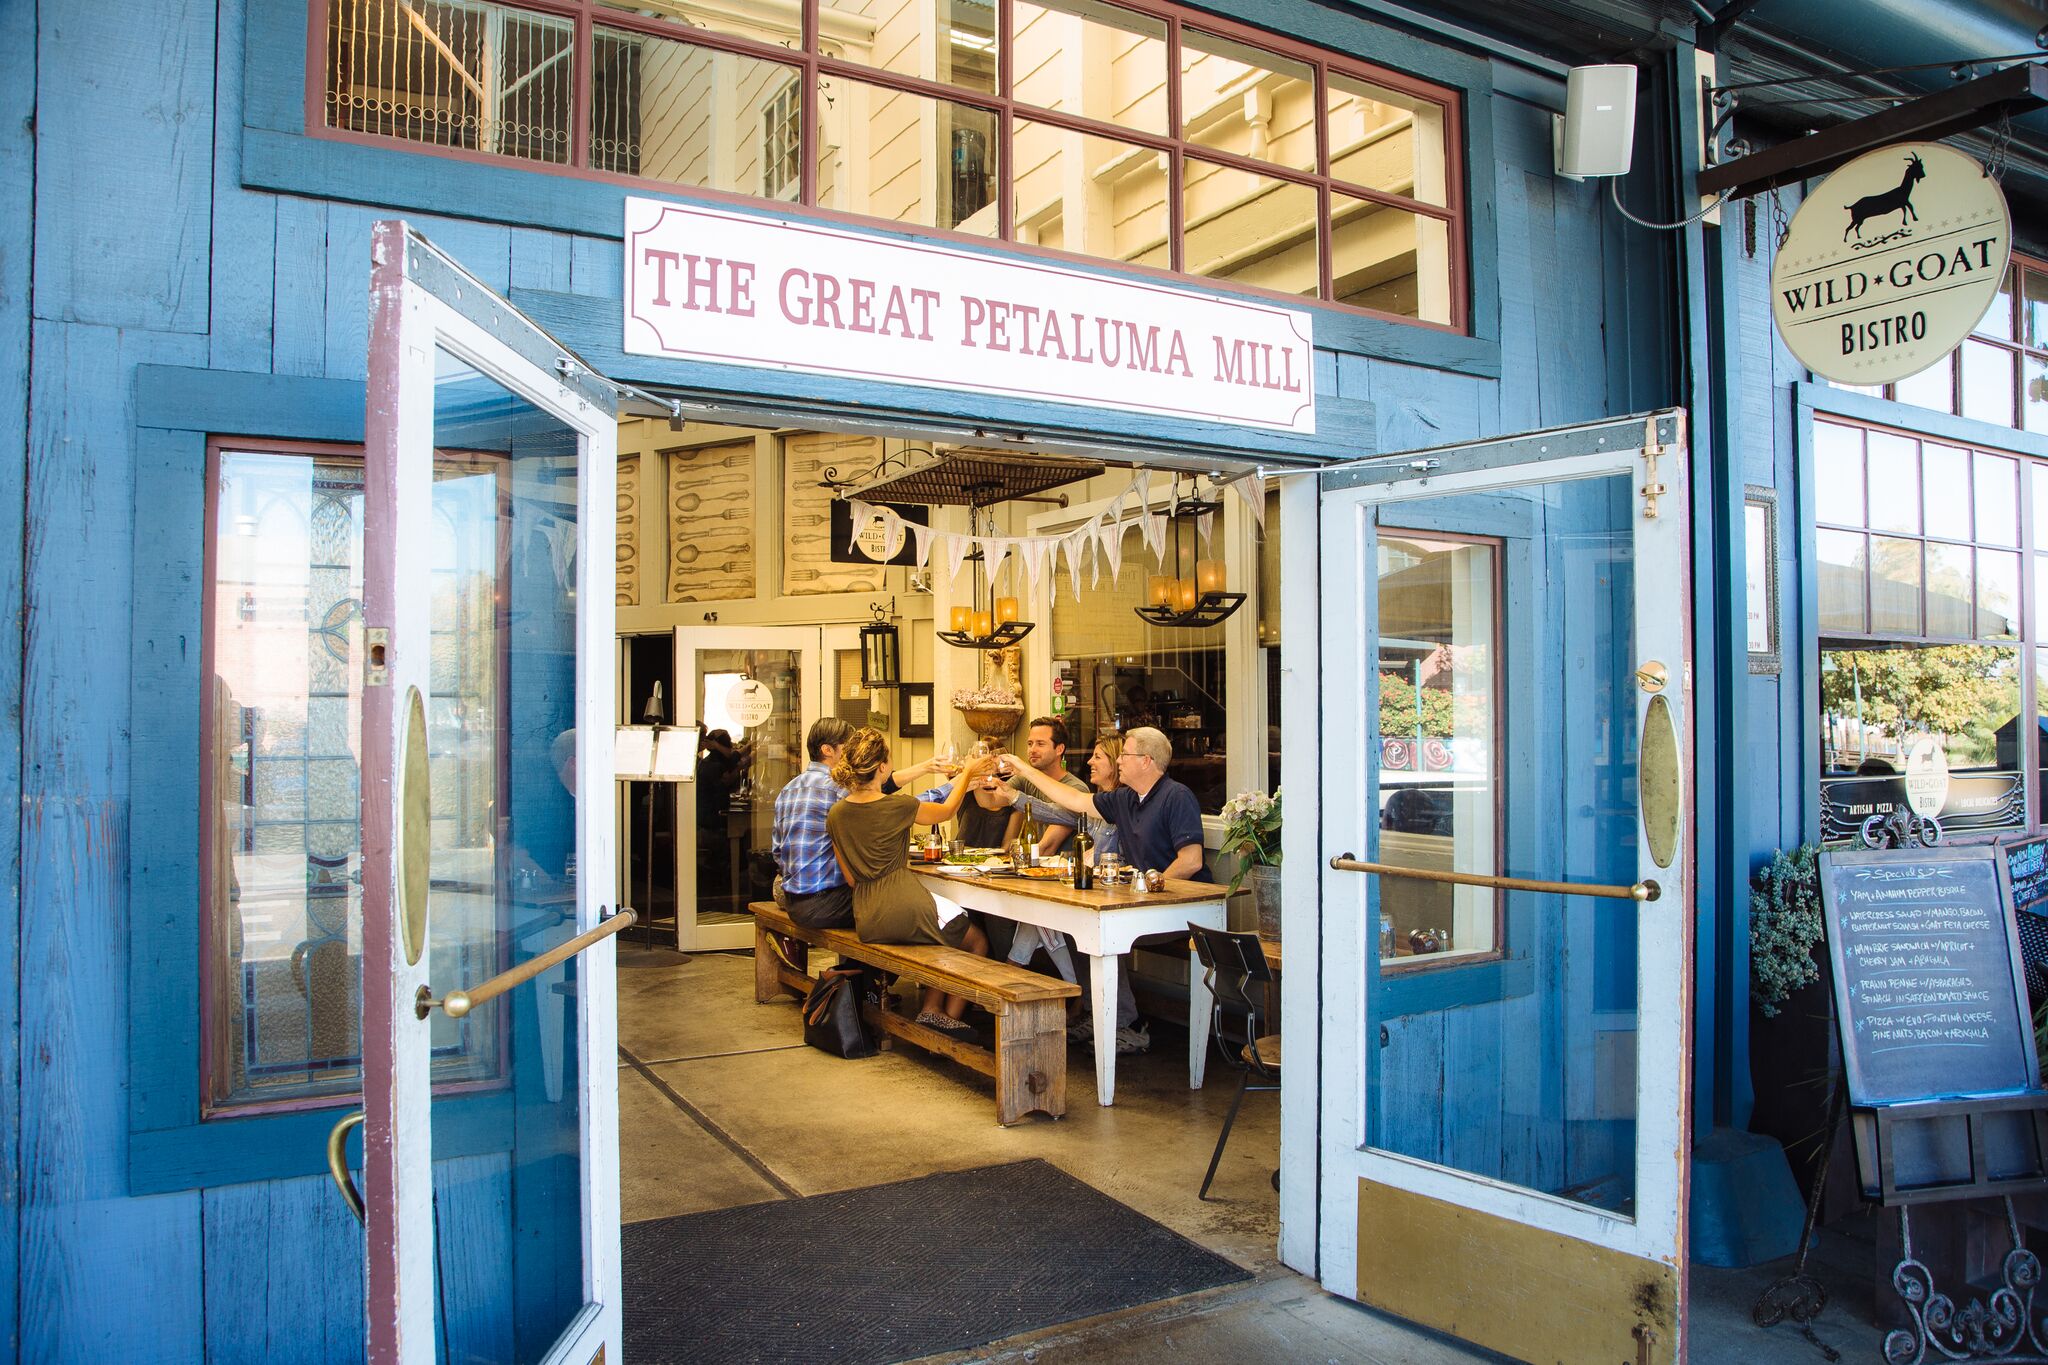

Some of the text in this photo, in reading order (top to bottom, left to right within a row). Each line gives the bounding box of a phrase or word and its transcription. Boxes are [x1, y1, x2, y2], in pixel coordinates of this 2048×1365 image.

[1783, 237, 1997, 314] WILD GOAT
[644, 248, 1302, 393] THE GREAT PETALUMA MILL
[1841, 311, 1927, 356] BISTRO
[703, 612, 718, 622] 45
[1849, 802, 1893, 815] ARTISAN PIZZA
[1907, 887, 1937, 899] PEPPER
